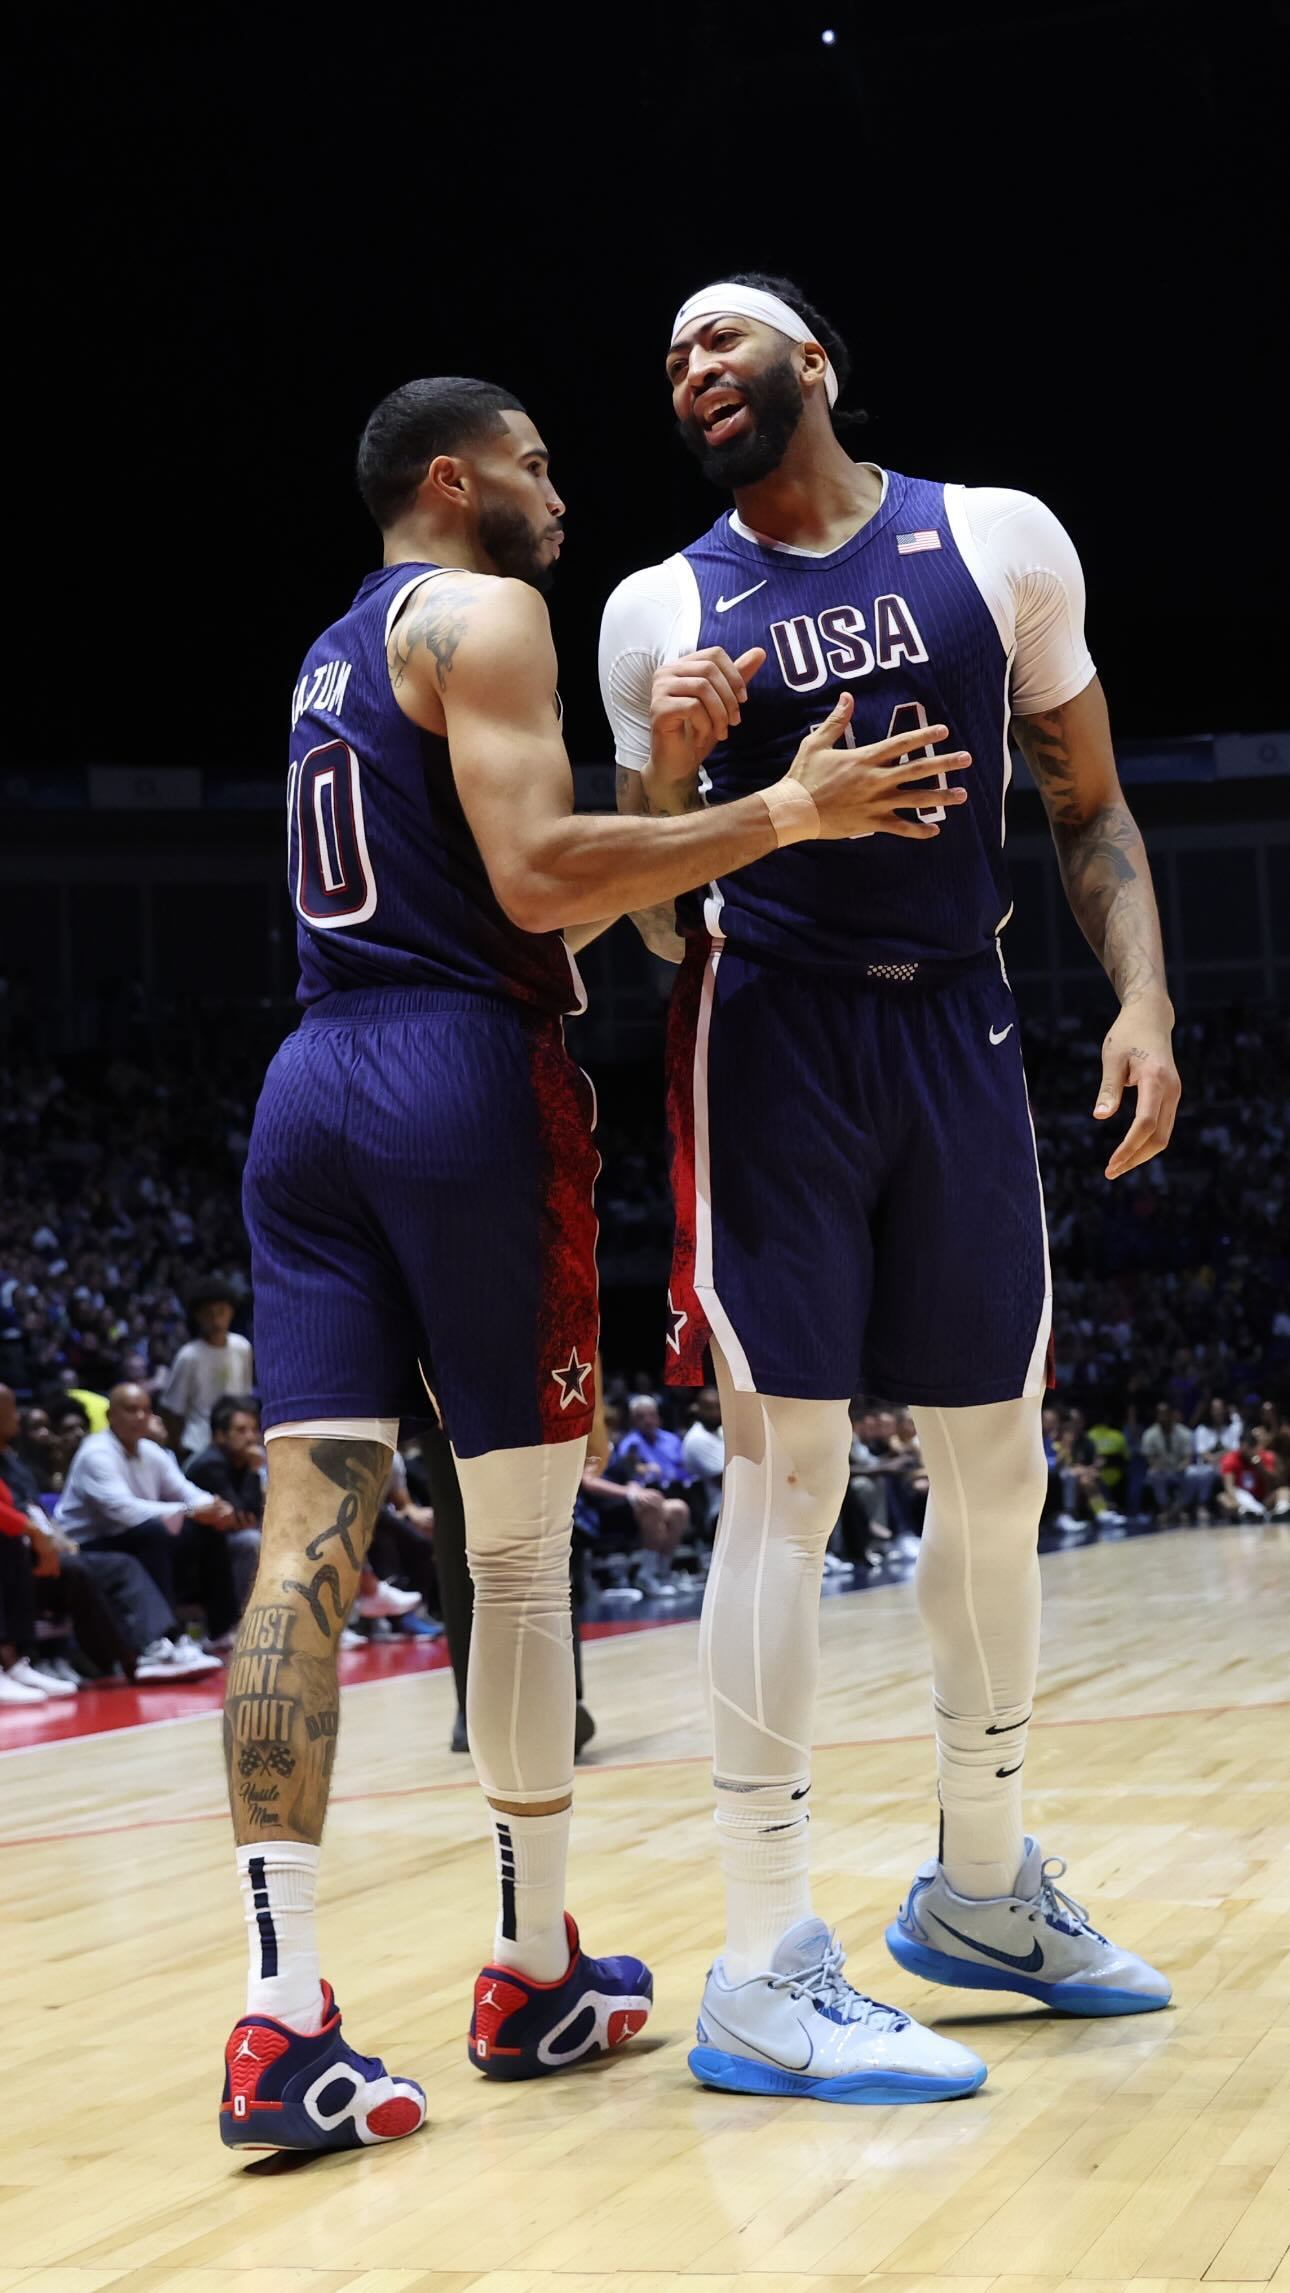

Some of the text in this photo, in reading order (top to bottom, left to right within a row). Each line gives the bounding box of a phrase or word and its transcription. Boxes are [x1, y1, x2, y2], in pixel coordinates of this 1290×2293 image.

[770, 594, 929, 692] USA
[810, 701, 947, 840] 4
[236, 1699, 294, 1745] QUIT
[233, 2095, 247, 2117] 0
